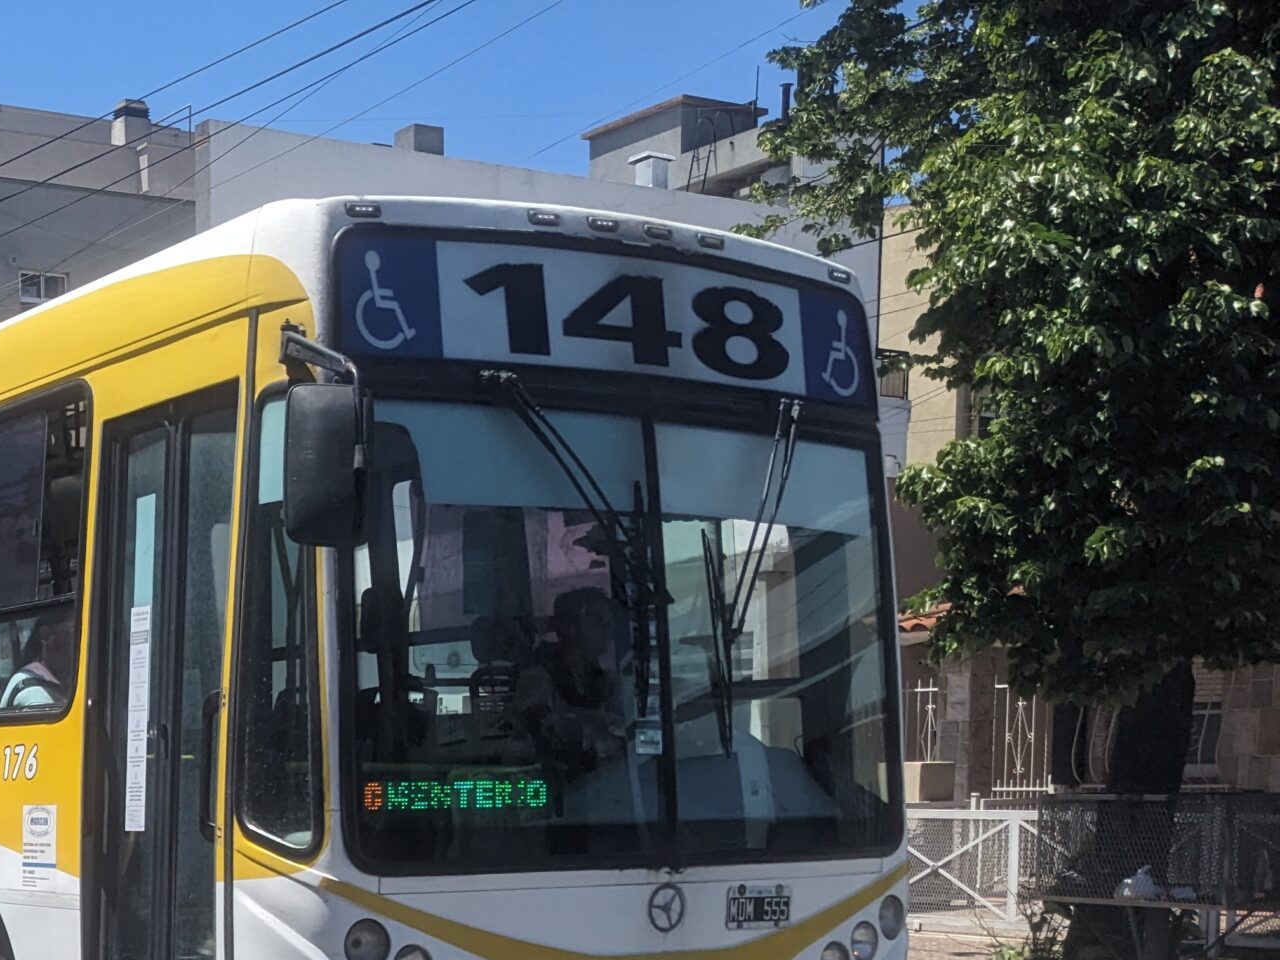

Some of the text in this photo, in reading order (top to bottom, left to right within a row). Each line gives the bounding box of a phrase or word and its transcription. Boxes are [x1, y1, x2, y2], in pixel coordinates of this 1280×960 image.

[463, 262, 790, 381] 148
[3, 743, 38, 781] 176
[730, 897, 788, 921] MDM 555
